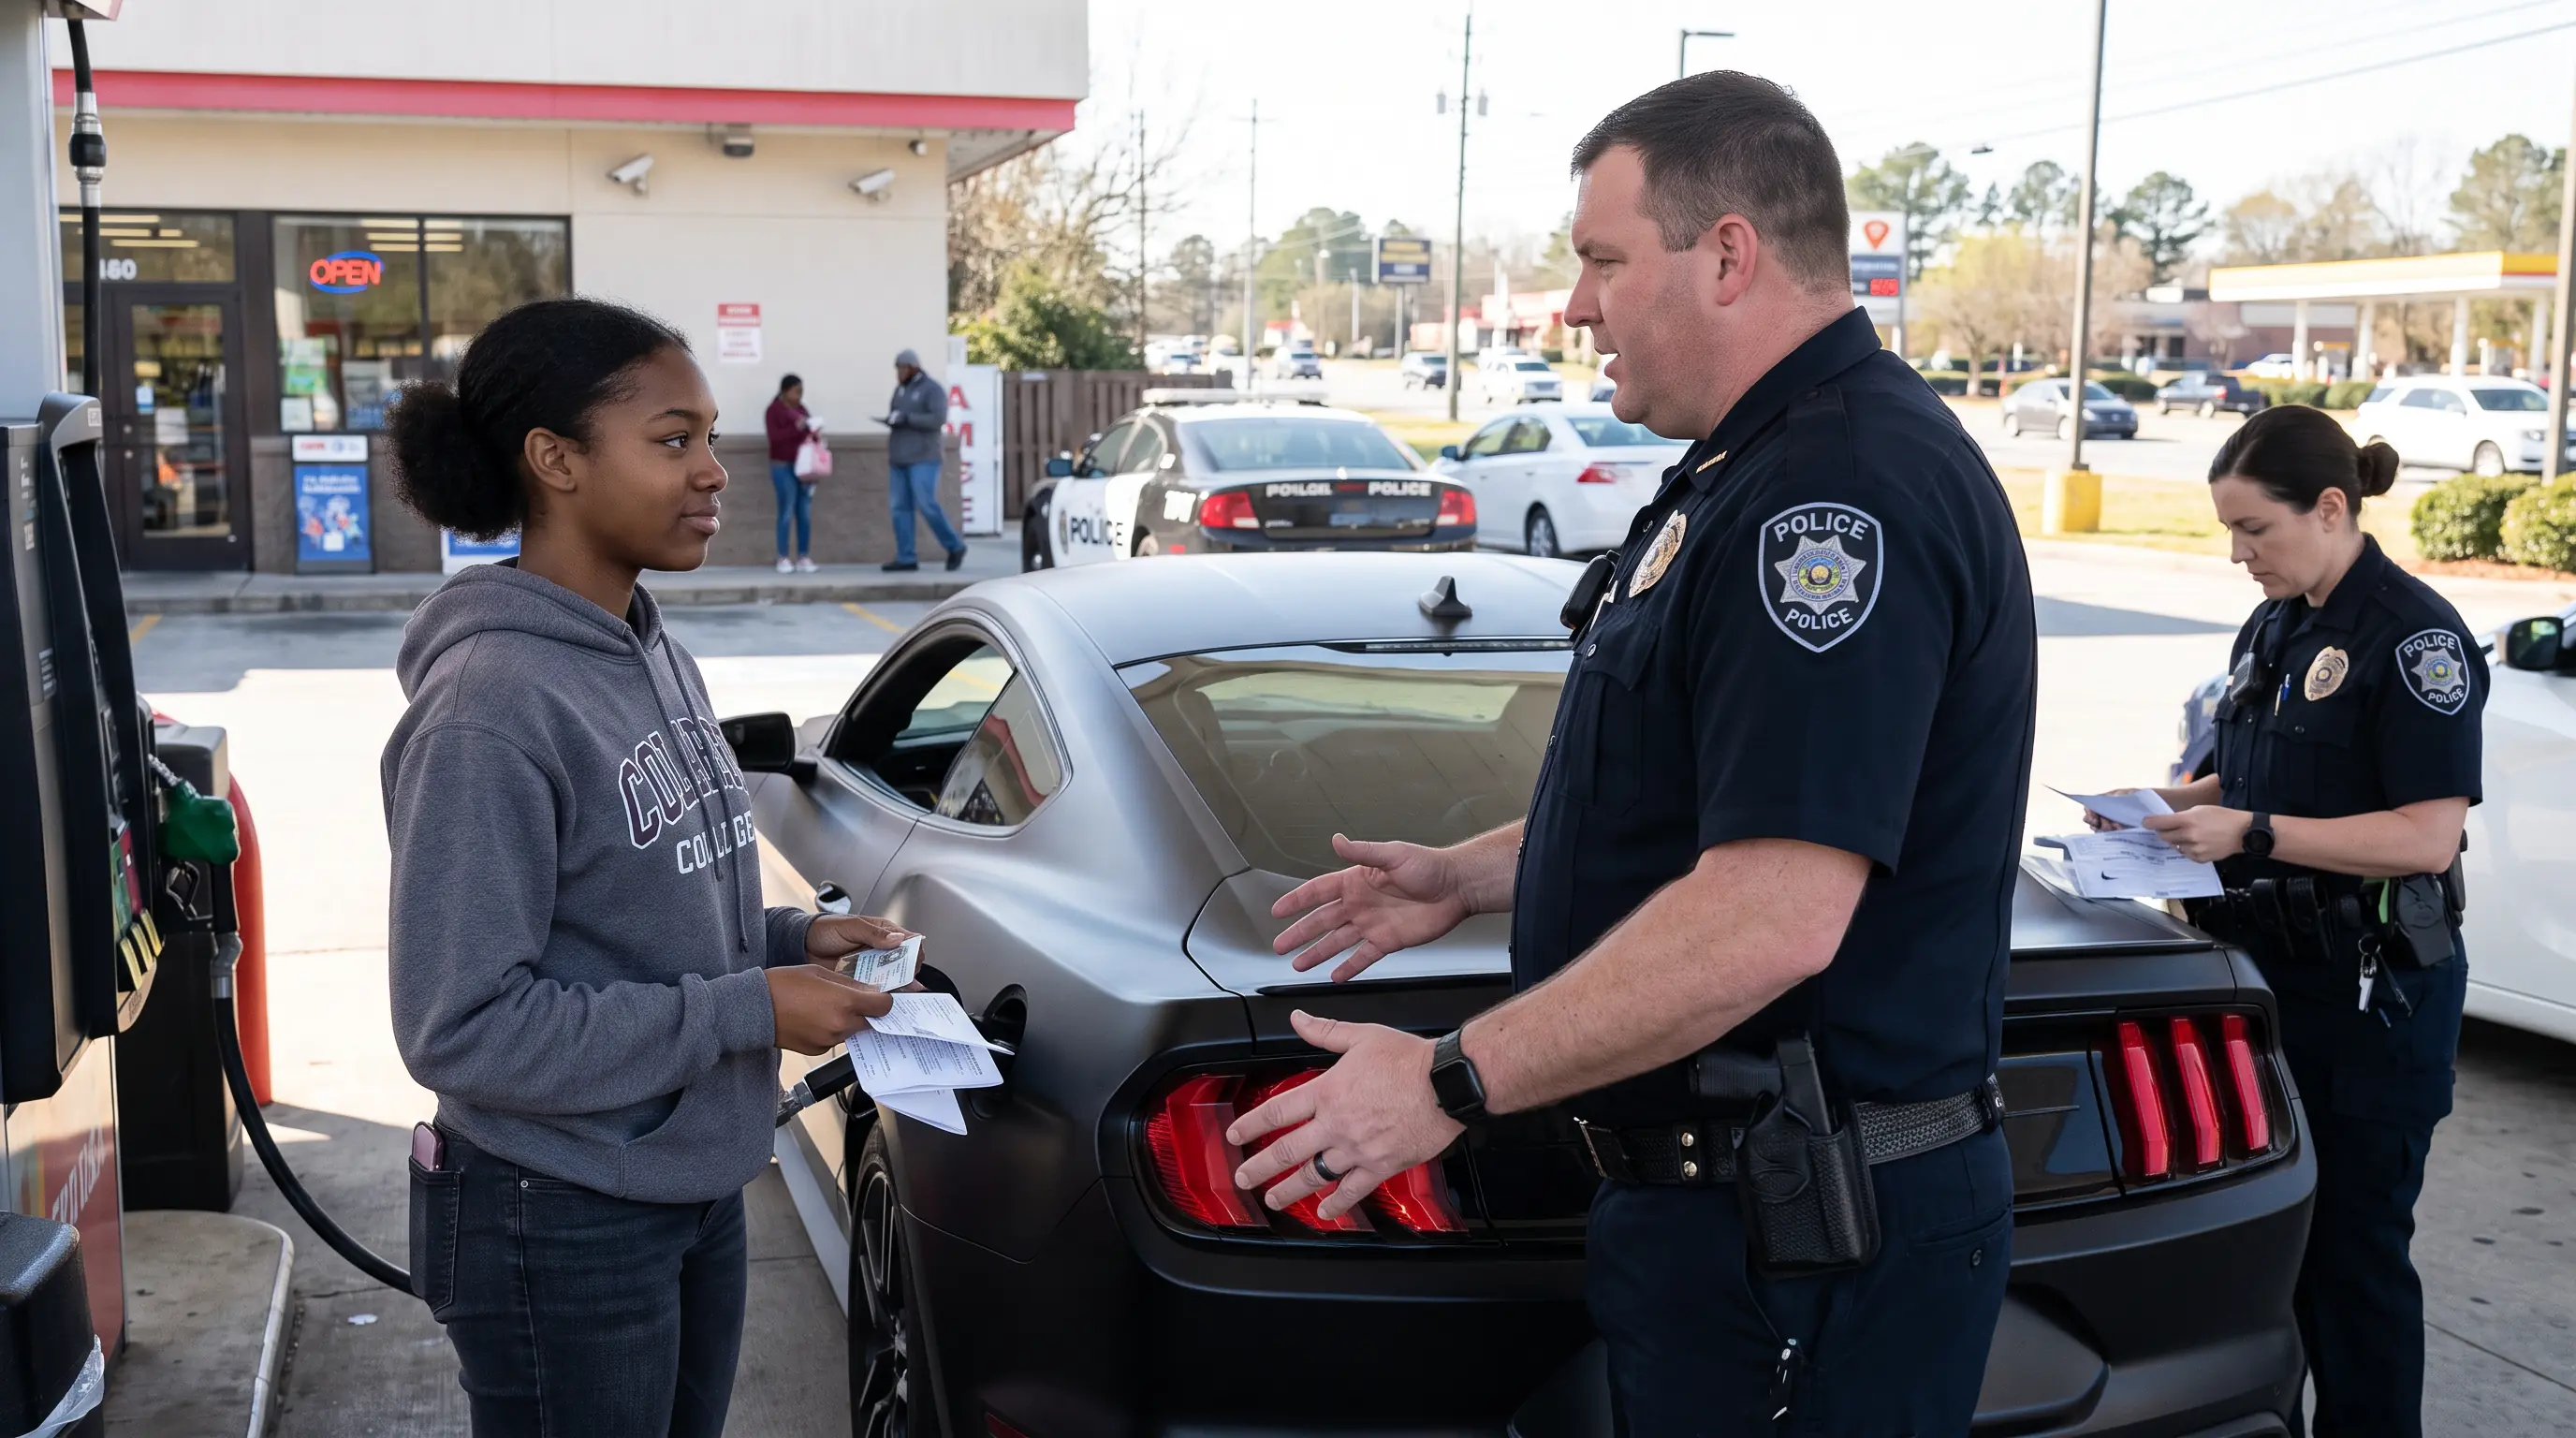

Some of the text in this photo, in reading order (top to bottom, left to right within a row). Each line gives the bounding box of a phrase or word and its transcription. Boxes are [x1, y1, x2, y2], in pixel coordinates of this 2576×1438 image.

[309, 258, 381, 286] OPEN
[1368, 481, 1431, 497] POLICE
[1070, 516, 1123, 547] POLICE
[1773, 512, 1869, 543] POLICE
[1784, 608, 1854, 630] POLICE
[2403, 635, 2455, 658] POLICE
